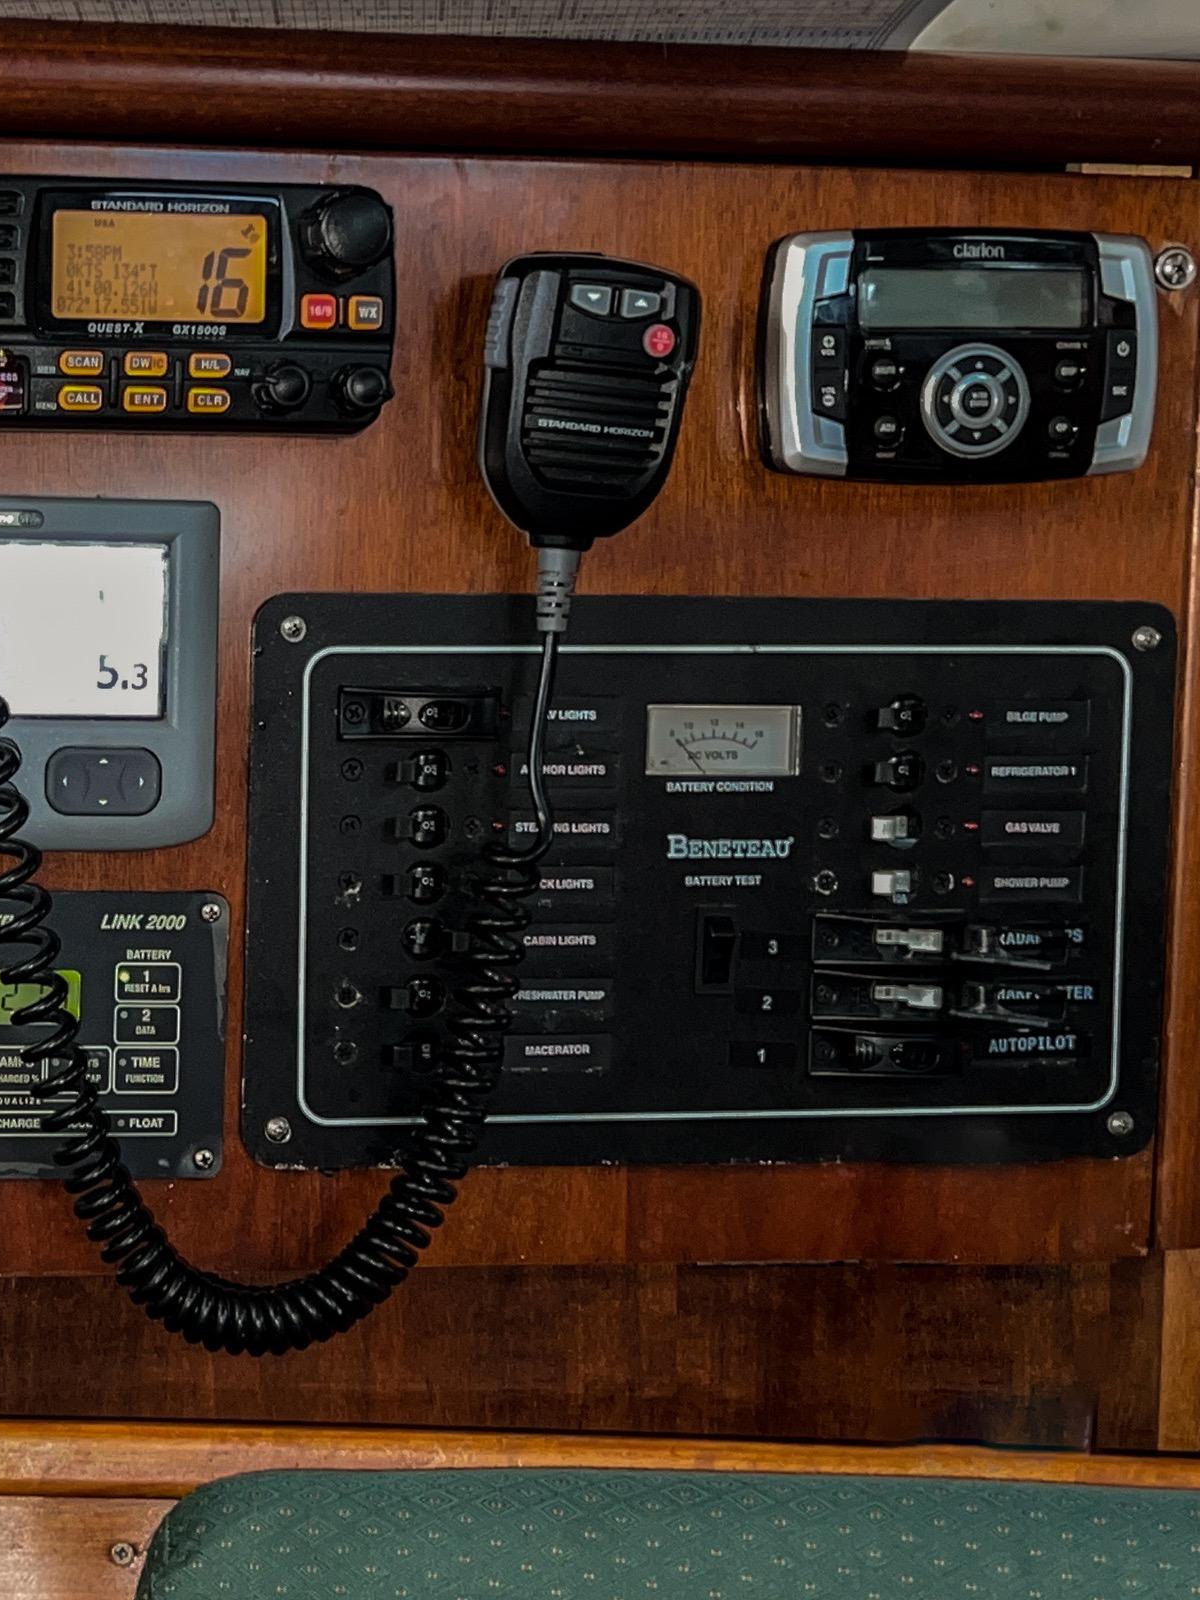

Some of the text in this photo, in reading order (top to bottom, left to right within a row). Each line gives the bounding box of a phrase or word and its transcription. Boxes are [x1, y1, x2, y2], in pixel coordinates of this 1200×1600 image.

[91, 200, 230, 213] STANDARD HORIZON
[953, 242, 1005, 259] clarion
[196, 247, 252, 318] 16
[358, 305, 378, 318] WX
[88, 322, 144, 334] QUEST-X
[68, 356, 99, 367] SCAN
[132, 358, 151, 368] DW
[201, 360, 220, 370] H/L
[67, 392, 97, 403] CALL
[134, 395, 159, 405] ENT
[197, 396, 222, 405] CLR
[538, 418, 654, 438] STANDARD HORIZON
[96, 655, 148, 690] 5.3
[558, 710, 597, 720] LIGHTS
[704, 751, 738, 760] VOLTS
[520, 764, 606, 775] AHOR LIGHTS
[991, 766, 1069, 777] REFRIGERATOR
[666, 782, 774, 792] BATTERY CONDITION
[571, 823, 610, 833] LIGHTS
[1005, 822, 1060, 833] GAS VALVE
[666, 834, 791, 859] BENETEAU
[556, 879, 594, 890] LIGHTS
[685, 875, 762, 887] BATTERY TEST
[994, 876, 1070, 888] SHOWER PUMP
[100, 914, 187, 930] LINK 2000
[523, 935, 596, 945] CABIN LIGHTS
[768, 939, 778, 954] 3
[126, 949, 172, 960] BATTERY
[142, 970, 150, 982] 1
[124, 983, 149, 993] RESET
[577, 990, 605, 1000] PUMP
[761, 995, 772, 1010] 2
[142, 1009, 151, 1022] 2
[135, 1025, 156, 1035] DATA
[989, 1034, 1077, 1053] AUTOPILOT
[525, 1044, 590, 1056] MACERATOR
[757, 1048, 766, 1063] 1
[131, 1057, 160, 1068] TIME
[125, 1074, 164, 1084] FUNCTION
[129, 1118, 164, 1129] FLOAT
